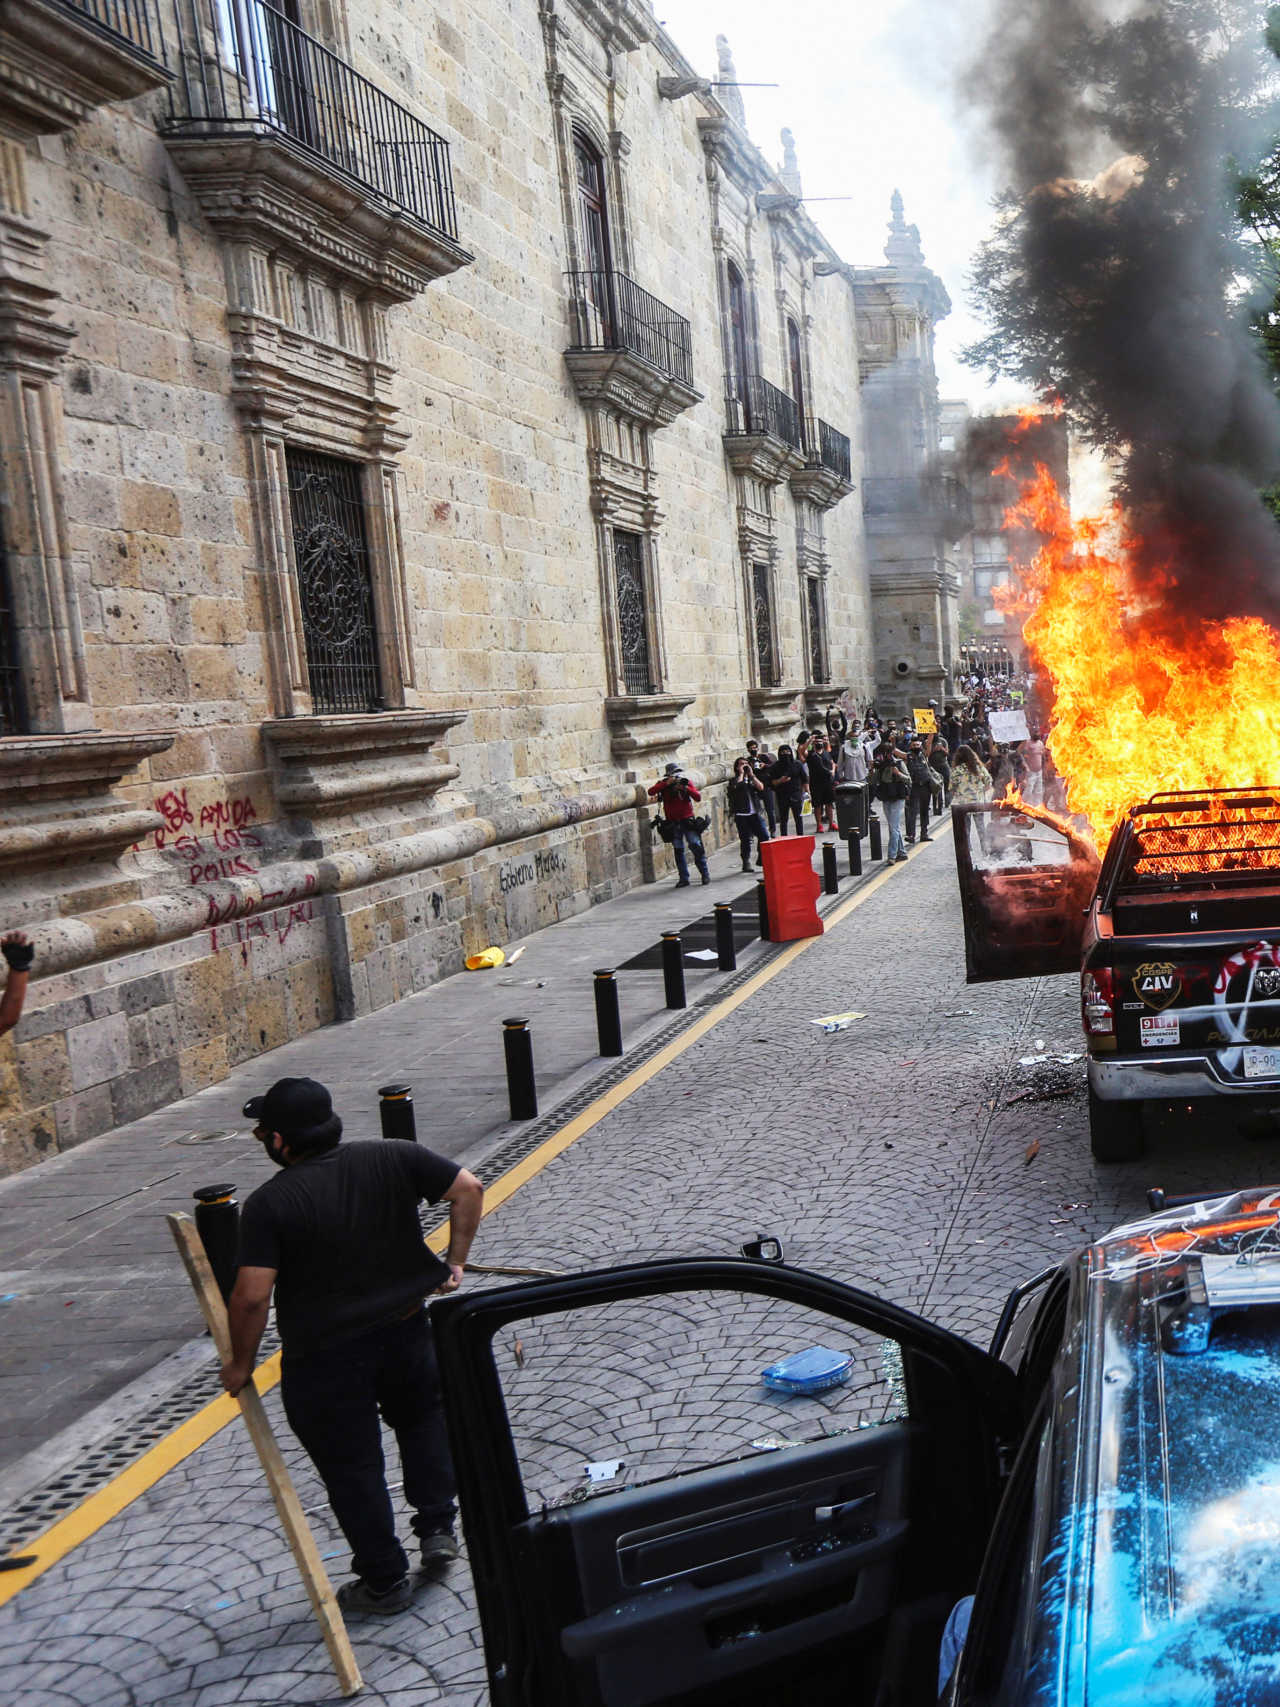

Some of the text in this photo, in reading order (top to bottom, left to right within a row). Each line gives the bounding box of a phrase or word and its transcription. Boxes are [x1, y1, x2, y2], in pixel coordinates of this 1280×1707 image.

[200, 798, 257, 828] AYUDA
[174, 823, 263, 861] SI LOS
[190, 854, 259, 885] POLIS
